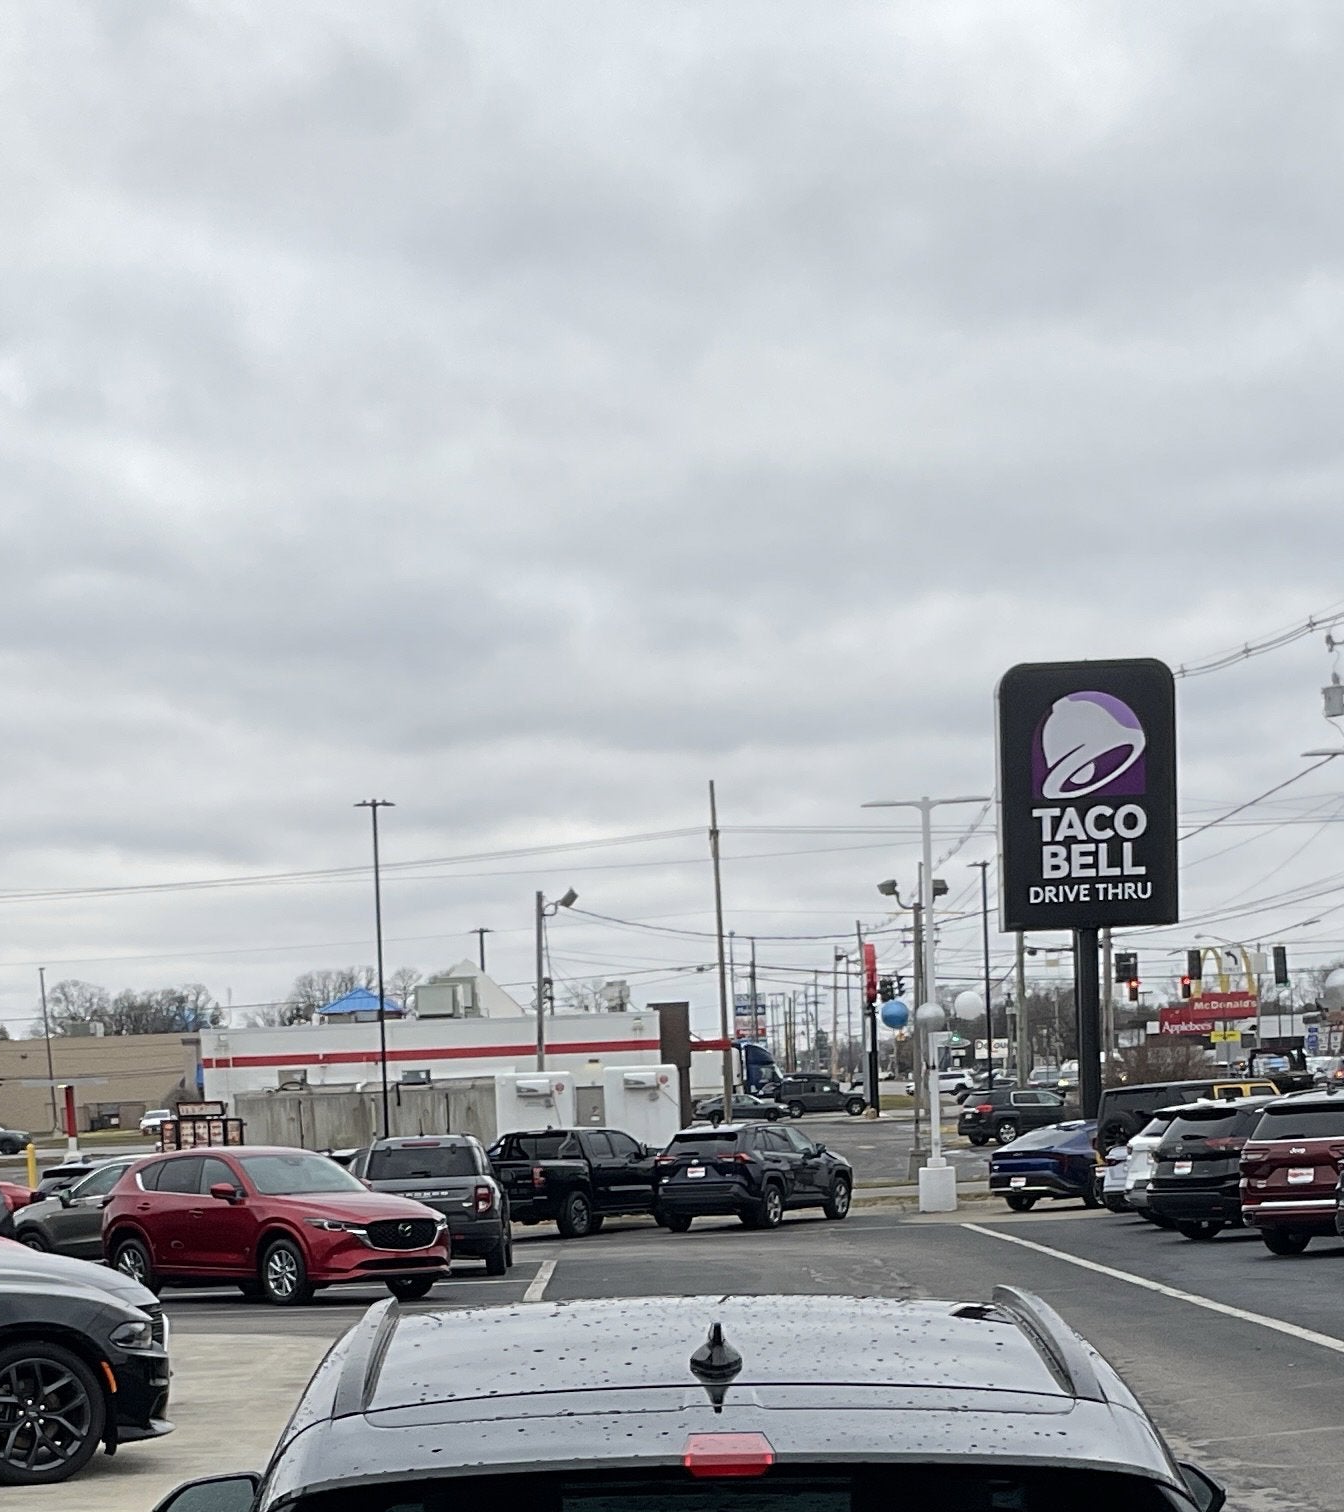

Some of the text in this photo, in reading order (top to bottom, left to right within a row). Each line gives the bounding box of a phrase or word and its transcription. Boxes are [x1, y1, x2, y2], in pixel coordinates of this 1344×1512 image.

[1032, 803, 1147, 842] TACO
[1042, 841, 1146, 880] BELL
[1029, 882, 1152, 904] DRIVE THRU
[1193, 1000, 1257, 1010] McDonald's
